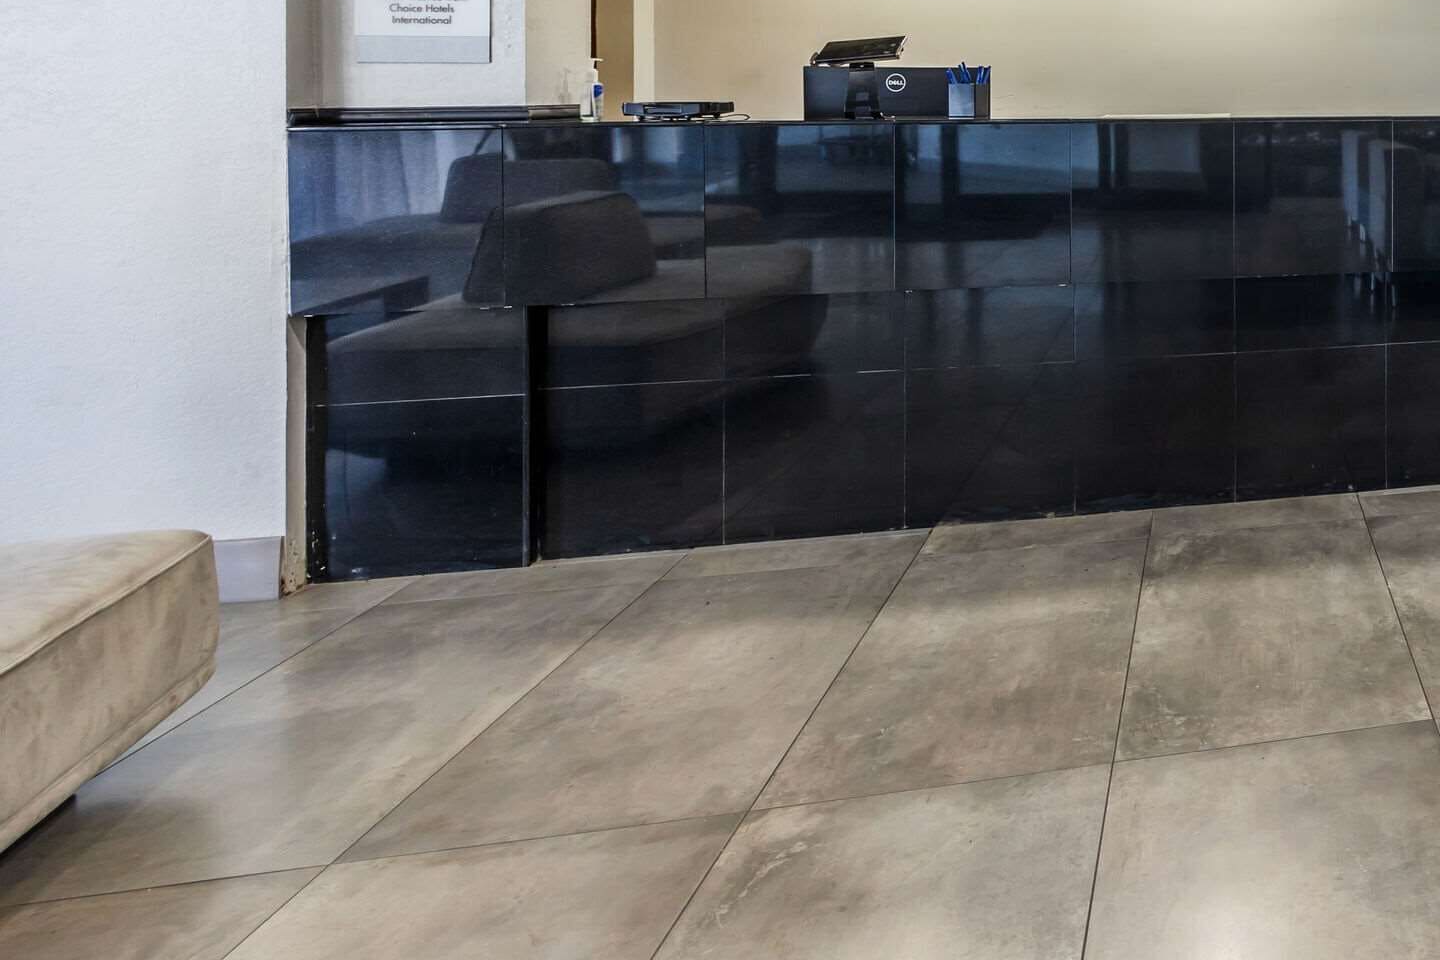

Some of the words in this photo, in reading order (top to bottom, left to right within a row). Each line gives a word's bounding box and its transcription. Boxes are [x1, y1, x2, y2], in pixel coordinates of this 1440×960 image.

[389, 3, 423, 13] Choice
[425, 4, 455, 13] Hotels
[392, 15, 452, 25] International
